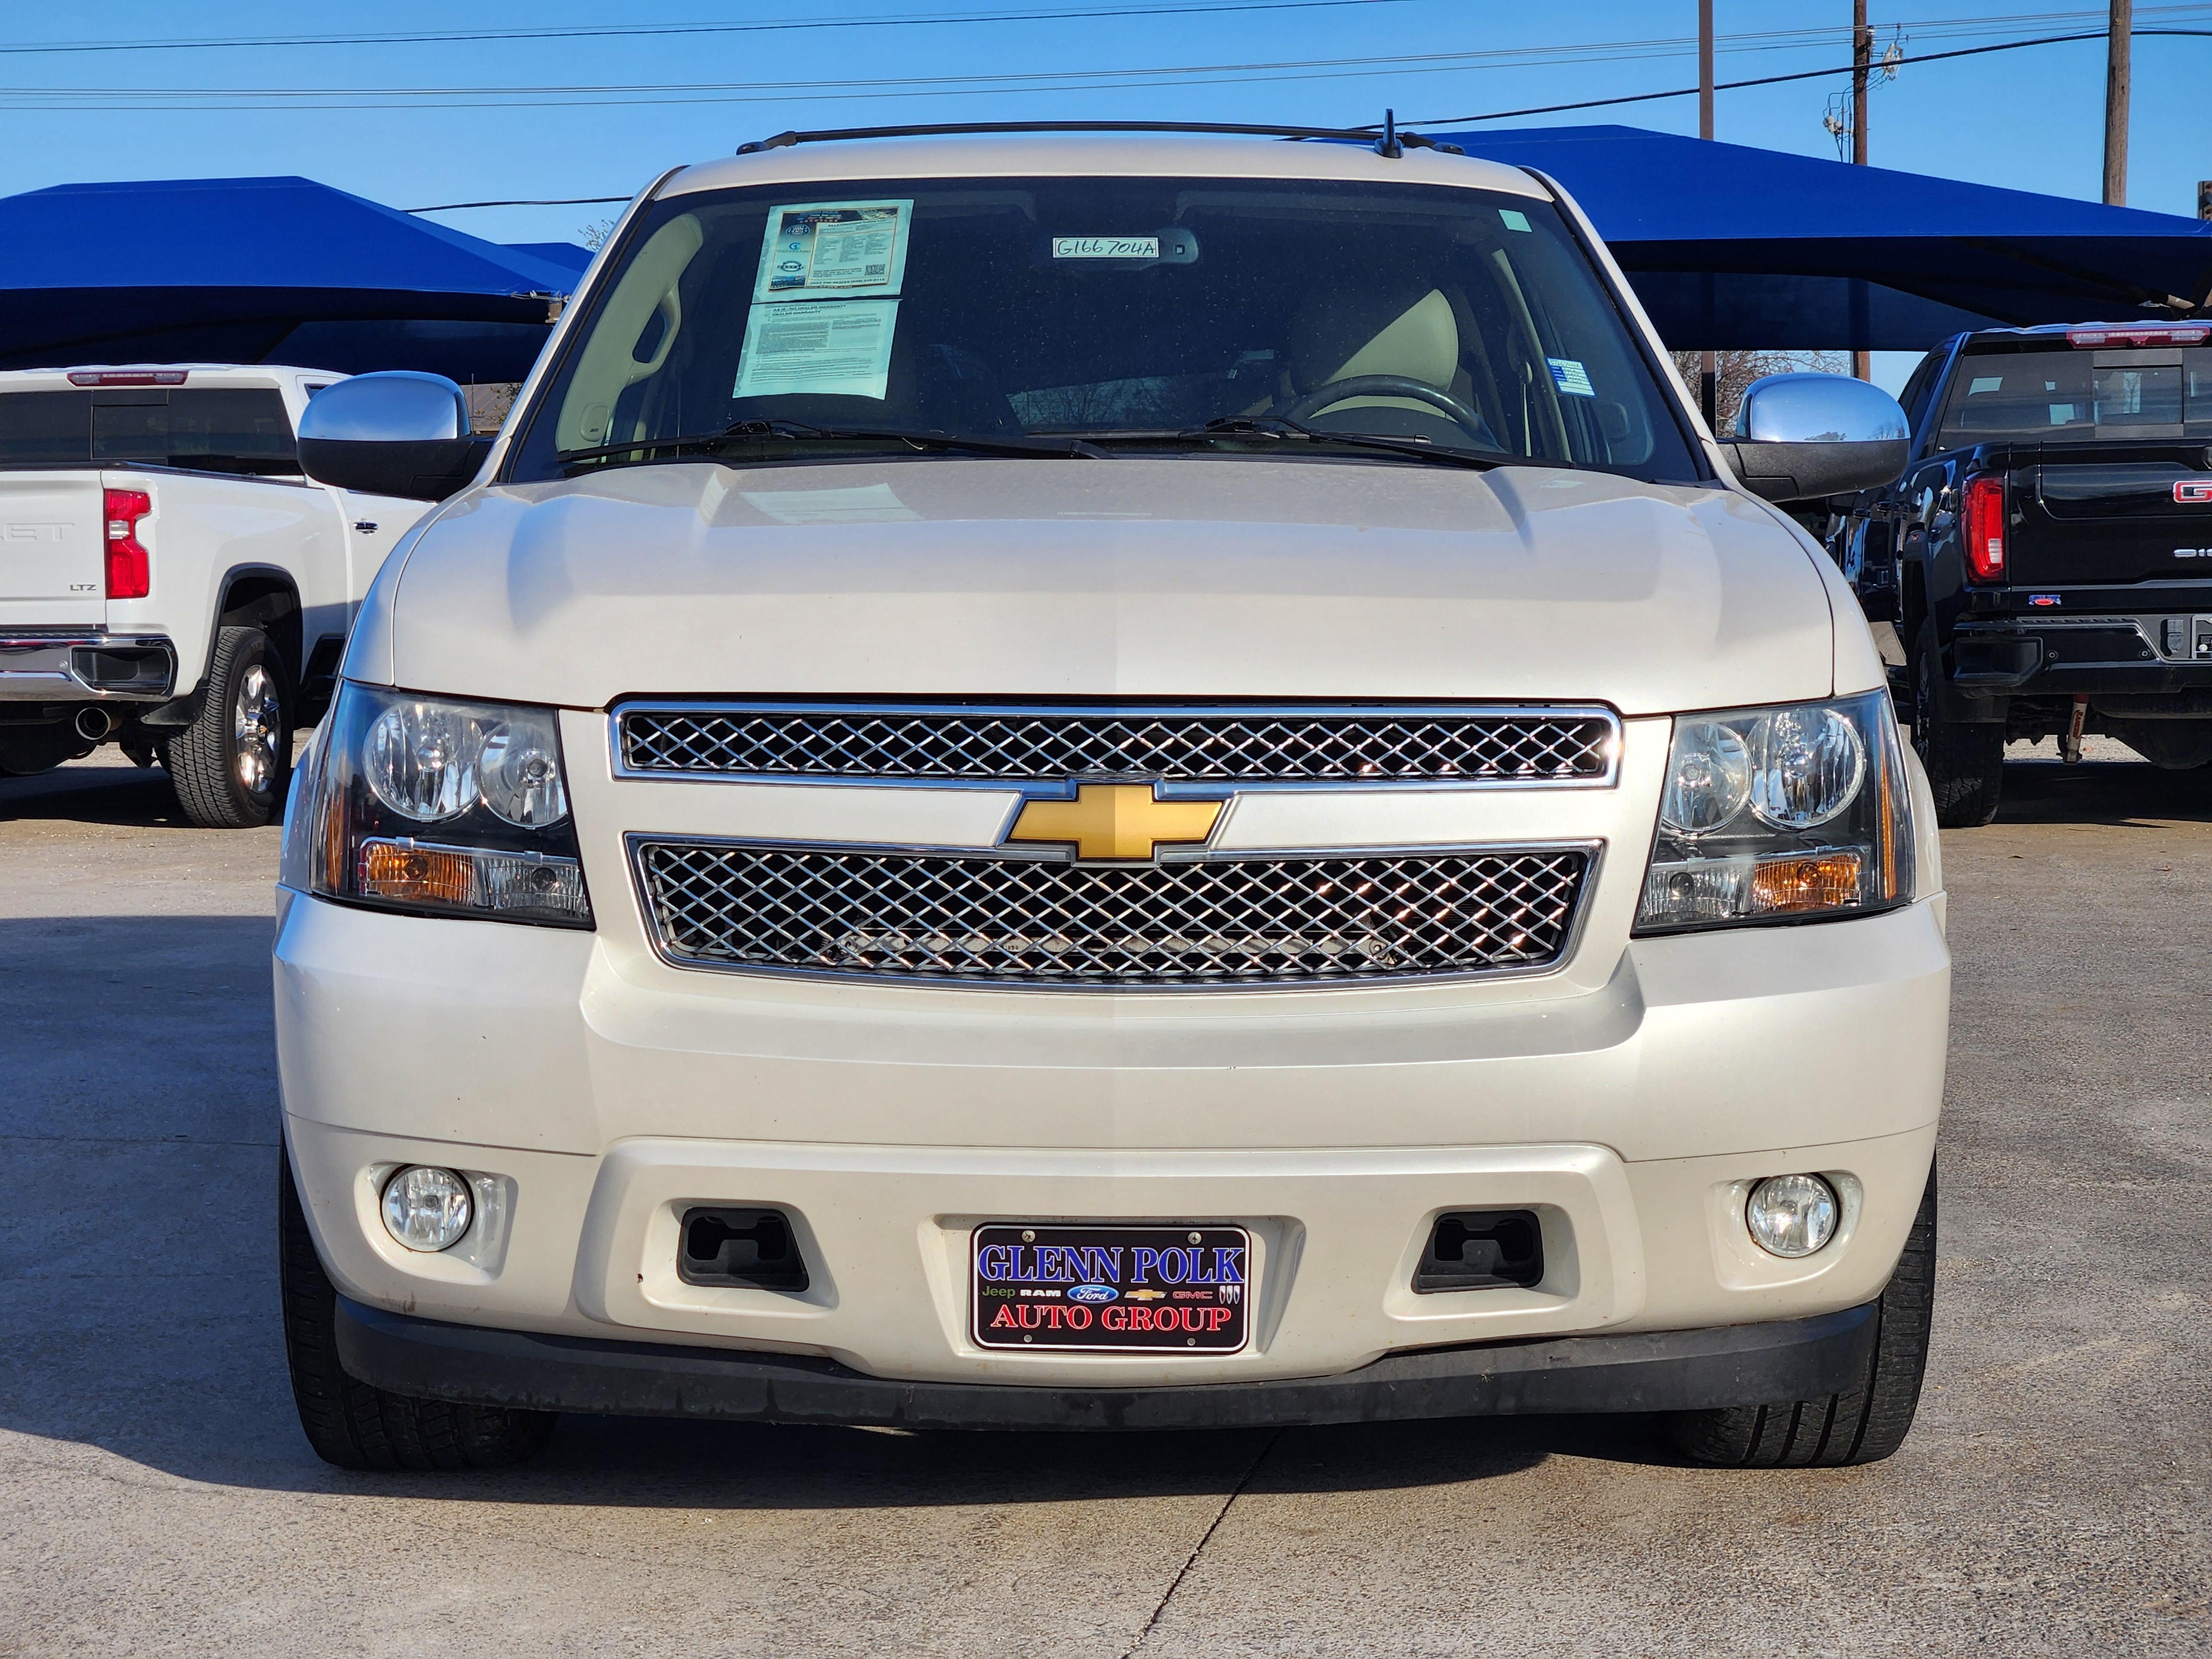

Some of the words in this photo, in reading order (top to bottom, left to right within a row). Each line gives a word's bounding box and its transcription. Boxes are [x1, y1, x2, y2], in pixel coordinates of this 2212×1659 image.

[978, 1244, 1124, 1282] GLENN
[1130, 1246, 1245, 1284] POLK
[982, 1285, 1016, 1299] Jeep
[1076, 1287, 1109, 1301] Ford
[1172, 1291, 1213, 1300] GMC
[990, 1304, 1092, 1329] AUTO
[1102, 1306, 1232, 1331] GROUP
